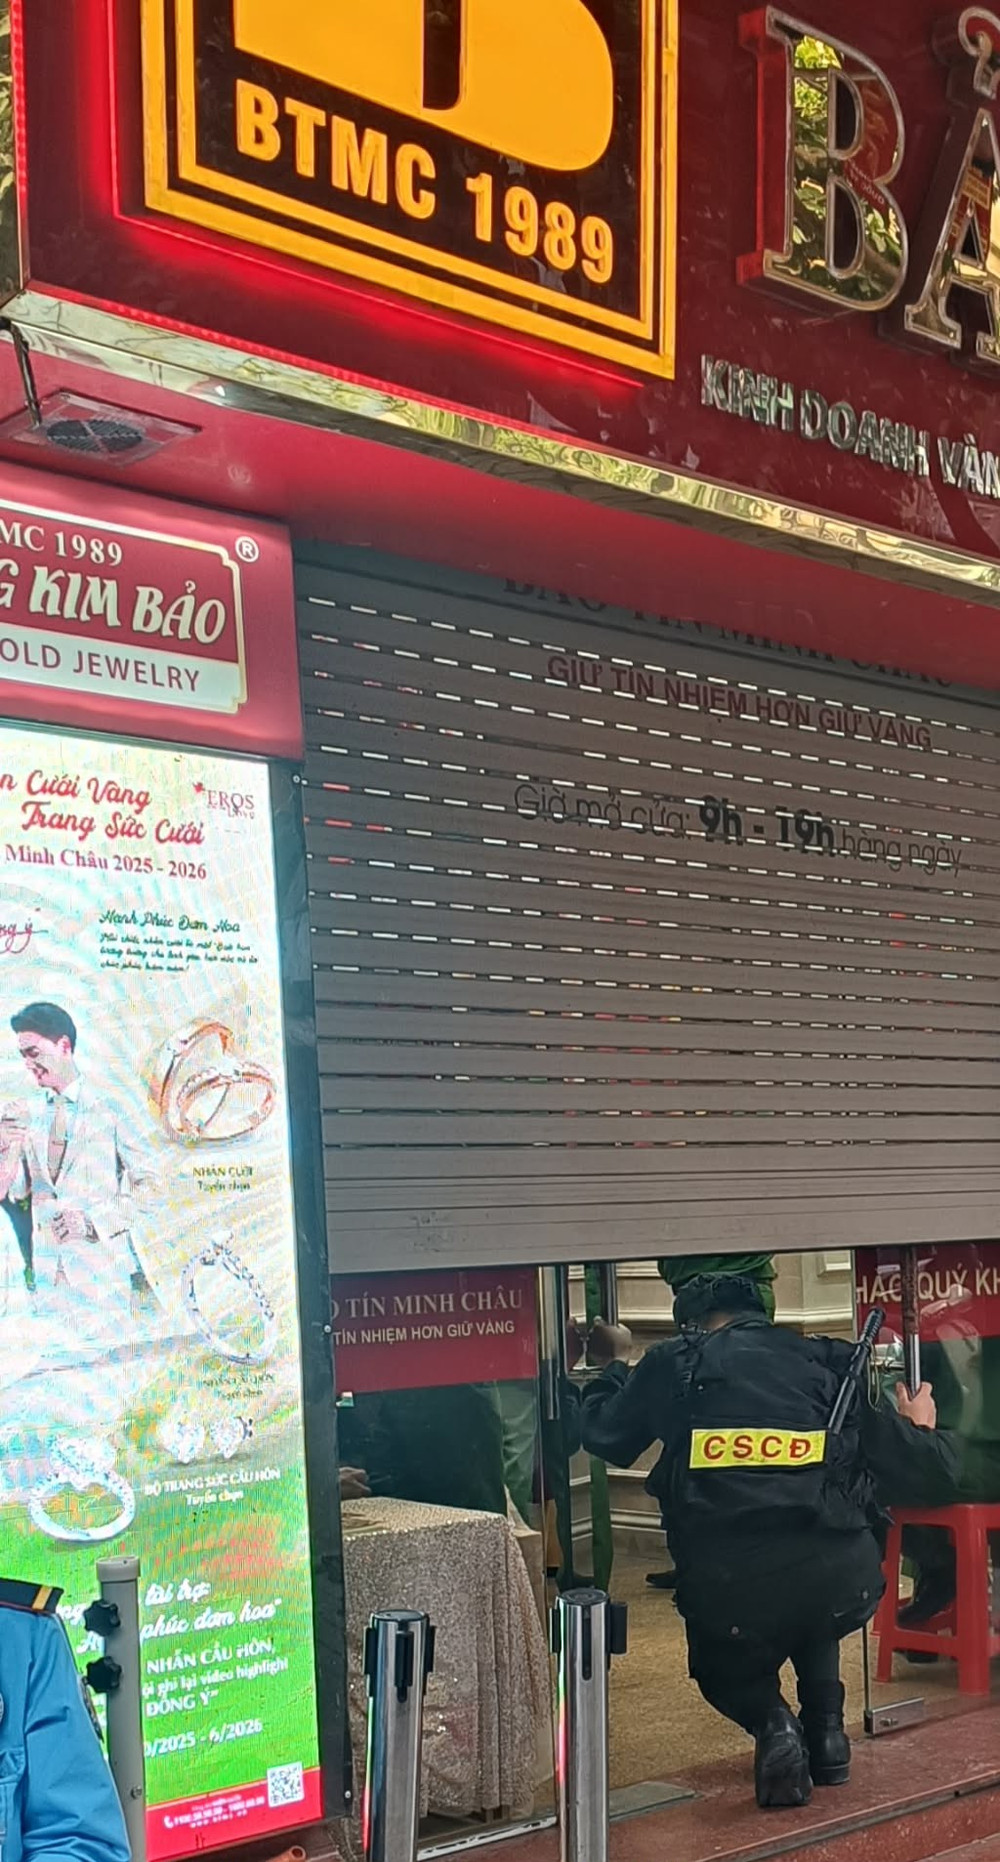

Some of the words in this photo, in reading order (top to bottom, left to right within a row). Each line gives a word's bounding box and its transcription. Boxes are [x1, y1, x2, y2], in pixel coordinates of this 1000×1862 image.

[236, 78, 437, 220] BTMC
[465, 172, 613, 284] 1989
[700, 352, 794, 432] KINH
[799, 389, 931, 477] DOANH
[54, 531, 123, 566] 1989
[29, 565, 121, 626] KIM
[132, 580, 226, 643] BẢO
[73, 650, 200, 692] JEWELRY
[27, 769, 81, 798] Cưới
[87, 777, 152, 815] Vàng
[207, 789, 255, 810] EROS
[21, 800, 96, 841] Trang
[104, 811, 148, 839] Sức
[155, 818, 206, 845] Cưới
[514, 783, 567, 824] Giờ
[575, 788, 622, 832] mở
[699, 794, 744, 847] 9h
[753, 825, 765, 835] -
[774, 804, 837, 857] 19h
[841, 828, 903, 872] hàng
[908, 839, 962, 878] ngày
[5, 843, 56, 867] Minh
[60, 848, 109, 870] Châu
[113, 854, 154, 874] 2025
[168, 860, 208, 881] 2026
[917, 1262, 969, 1301] QUÝ
[345, 1291, 386, 1319] TÍN
[392, 1293, 455, 1317] MINH
[460, 1284, 523, 1313] CHÂU
[361, 1325, 408, 1346] NHIỆM
[411, 1325, 443, 1340] HƠN
[447, 1322, 473, 1338] GIỮ
[477, 1317, 516, 1336] VÀNG
[702, 1434, 813, 1462] CSCĐ
[200, 1668, 234, 1687] video
